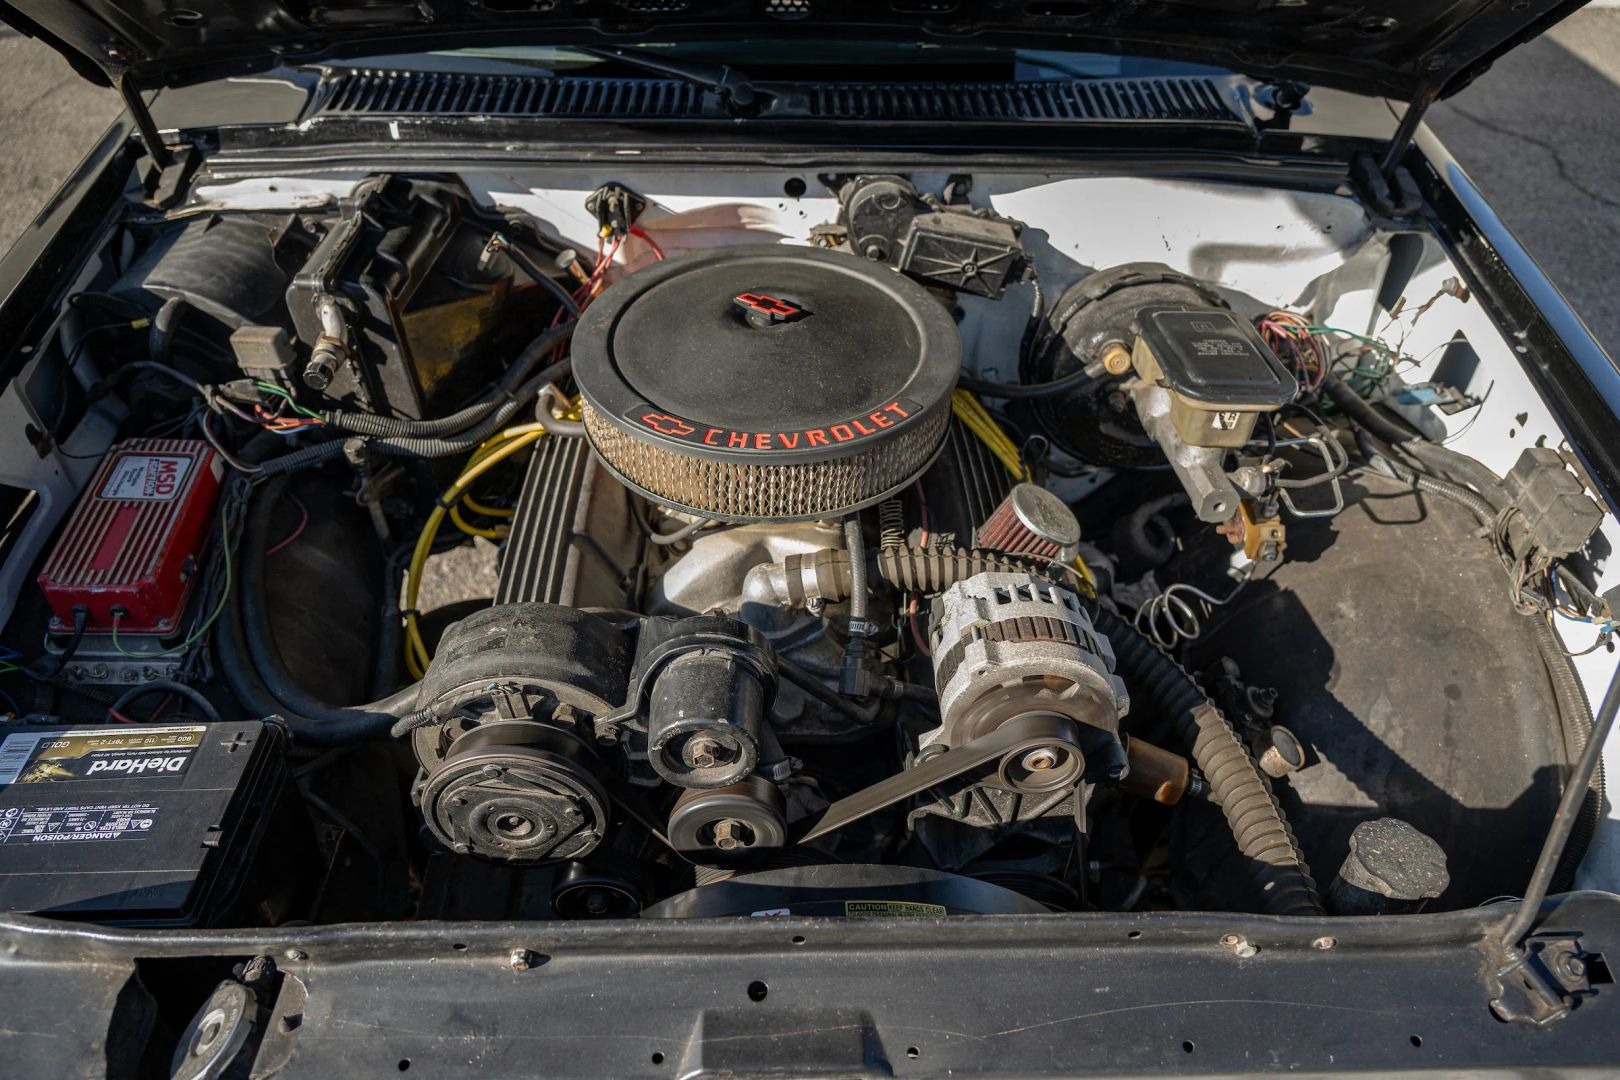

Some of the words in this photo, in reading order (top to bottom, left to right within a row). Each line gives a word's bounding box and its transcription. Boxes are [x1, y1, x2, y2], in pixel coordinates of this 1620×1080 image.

[704, 401, 909, 450] CHEVROLET
[156, 460, 178, 495] MSD
[41, 741, 71, 749] GOLD
[85, 756, 187, 776] DieHard
[32, 833, 113, 841] DANGER/POISON
[848, 903, 887, 911] CAUTION
